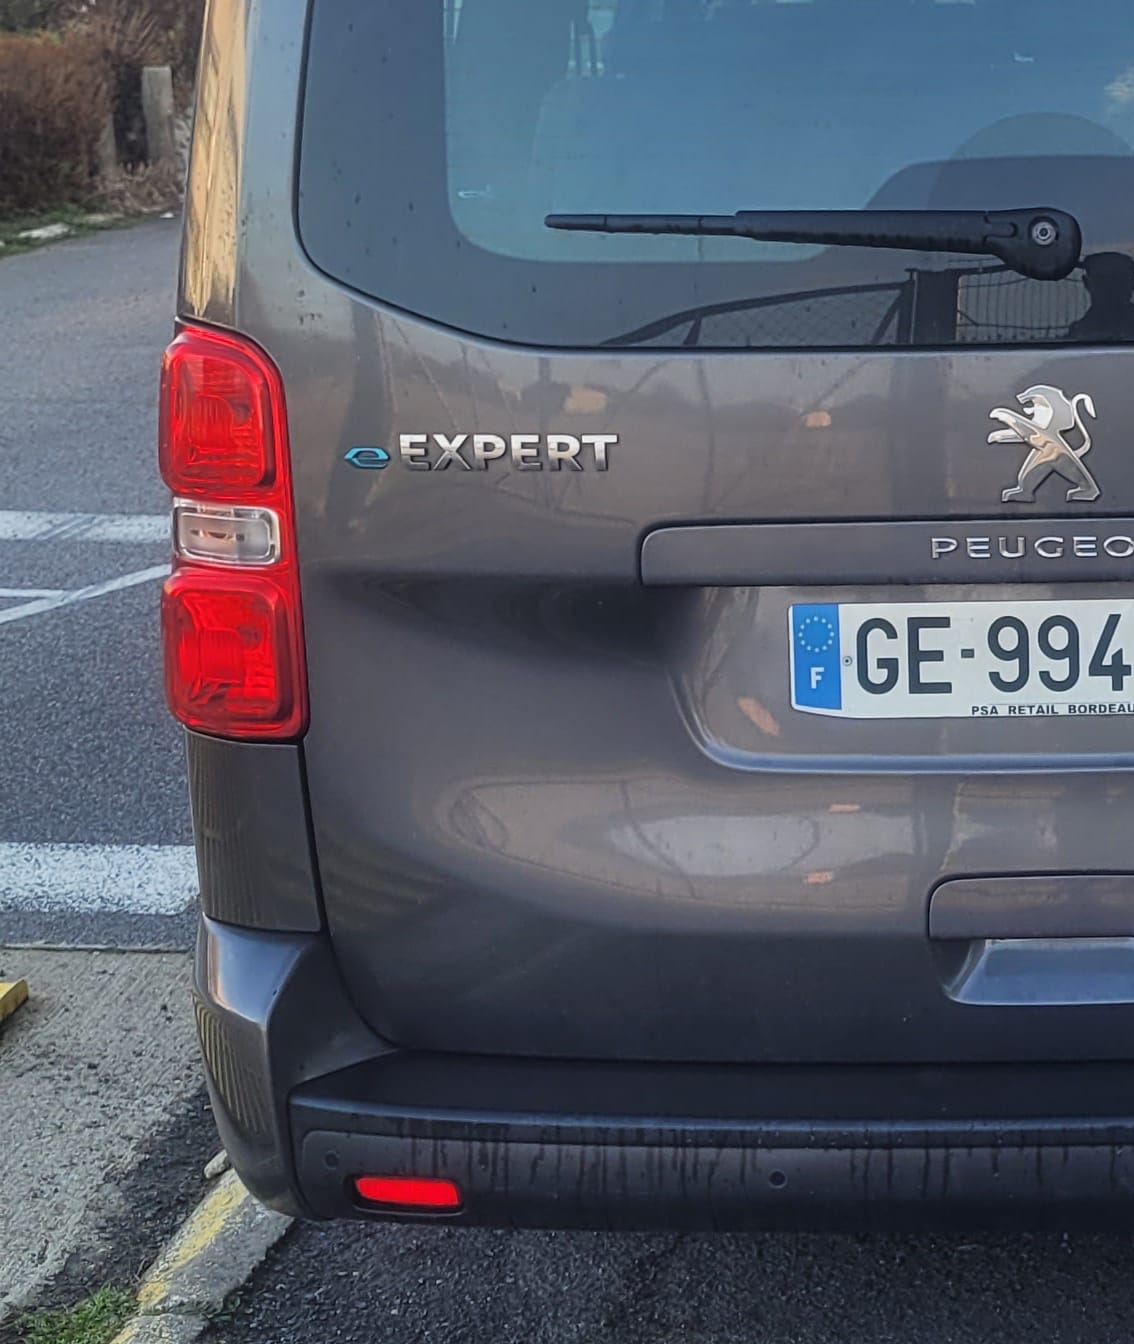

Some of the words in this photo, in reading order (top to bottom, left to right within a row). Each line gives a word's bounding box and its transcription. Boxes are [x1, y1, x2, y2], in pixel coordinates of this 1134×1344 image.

[399, 433, 619, 472] EXPERT
[809, 666, 825, 689] F
[971, 705, 999, 716] PSA
[1008, 704, 1060, 715] RETAIL
